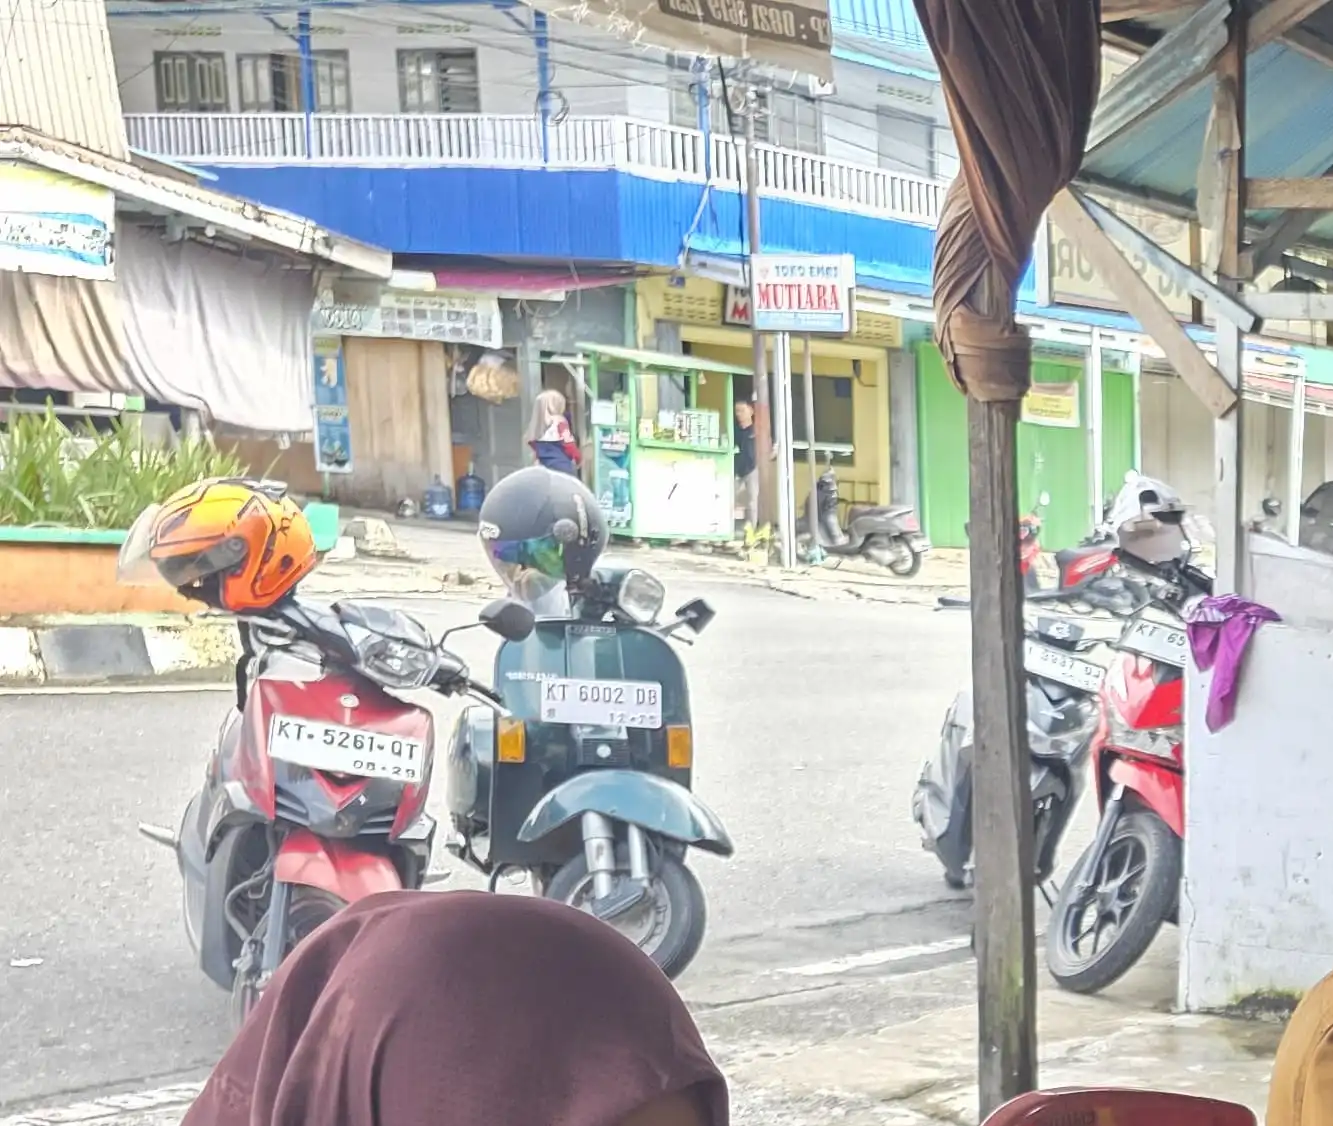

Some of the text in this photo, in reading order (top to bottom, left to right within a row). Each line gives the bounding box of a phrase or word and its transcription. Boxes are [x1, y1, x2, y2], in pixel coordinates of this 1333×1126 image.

[756, 283, 840, 311] MUTIARA
[1135, 623, 1161, 638] KT
[546, 683, 569, 700] KT
[579, 685, 624, 704] 6002
[278, 720, 306, 741] KT
[323, 728, 374, 753] 5261
